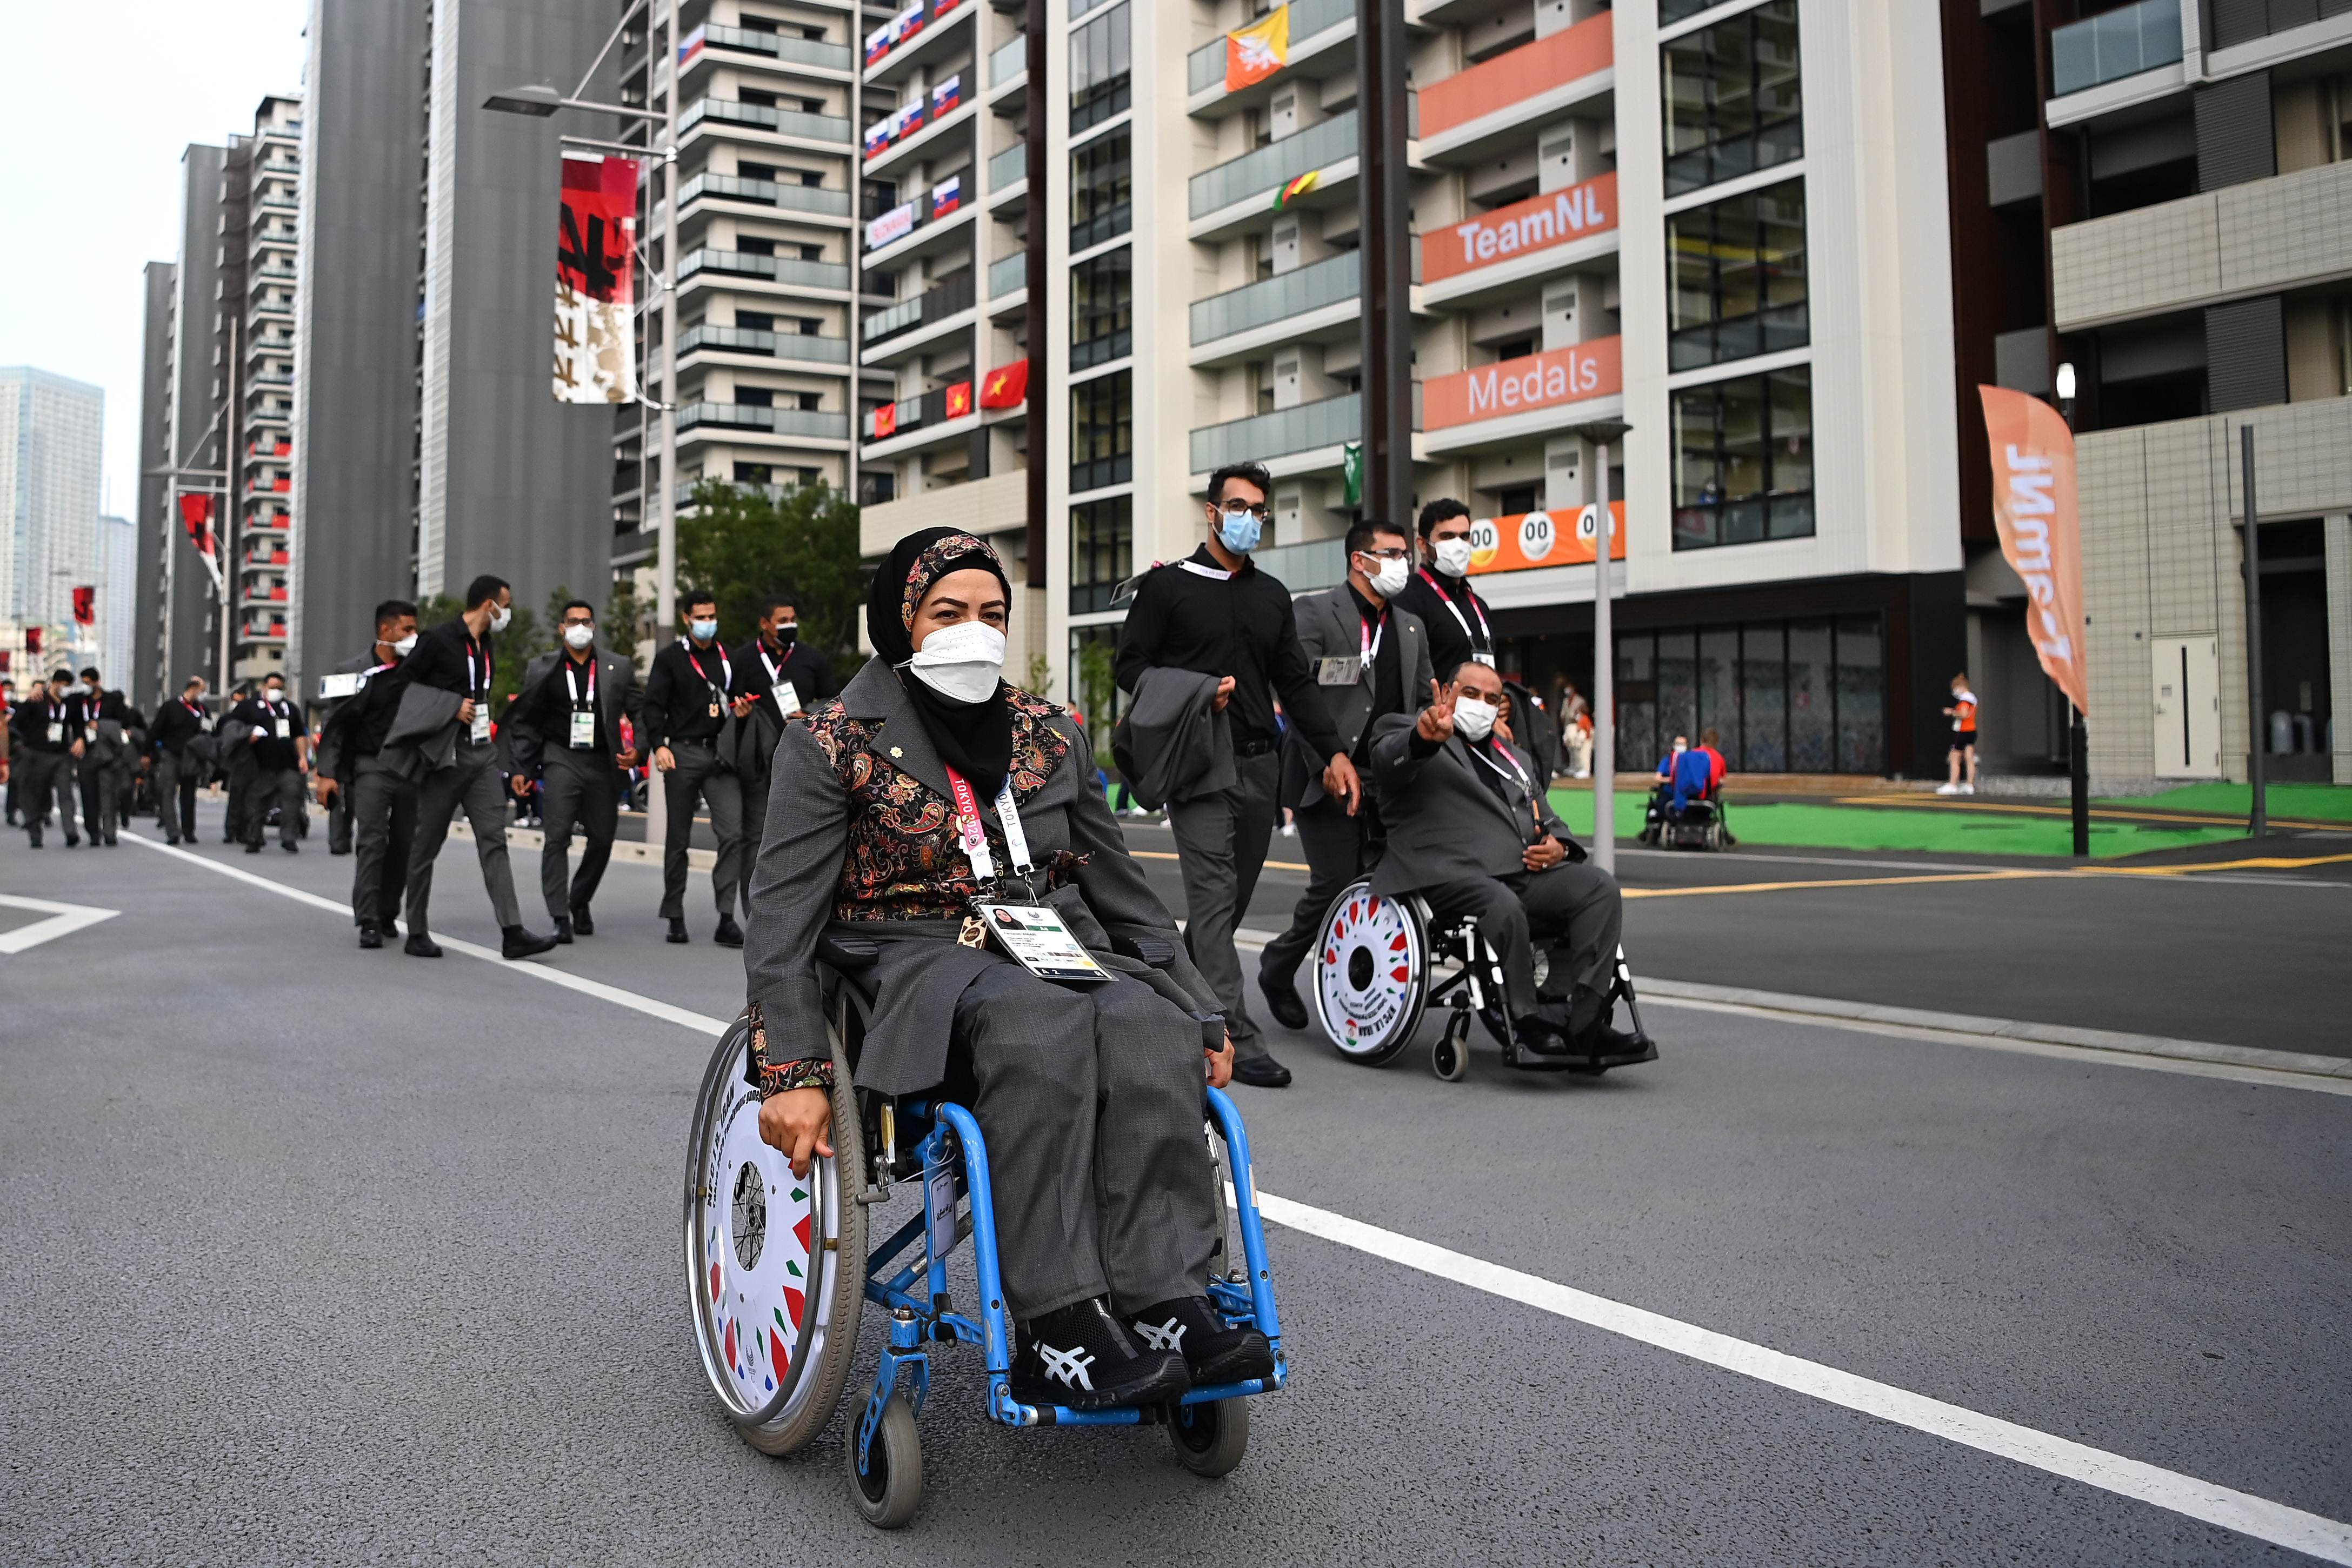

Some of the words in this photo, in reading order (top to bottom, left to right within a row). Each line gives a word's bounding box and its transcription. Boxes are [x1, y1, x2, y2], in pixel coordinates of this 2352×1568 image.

[1457, 185, 1604, 263] TeamNL
[1468, 351, 1598, 415] Medals
[1525, 521, 1547, 541] 00
[955, 778, 973, 813] TOKYO
[999, 793, 1016, 828] TOKYO
[721, 1080, 734, 1130] IRAN
